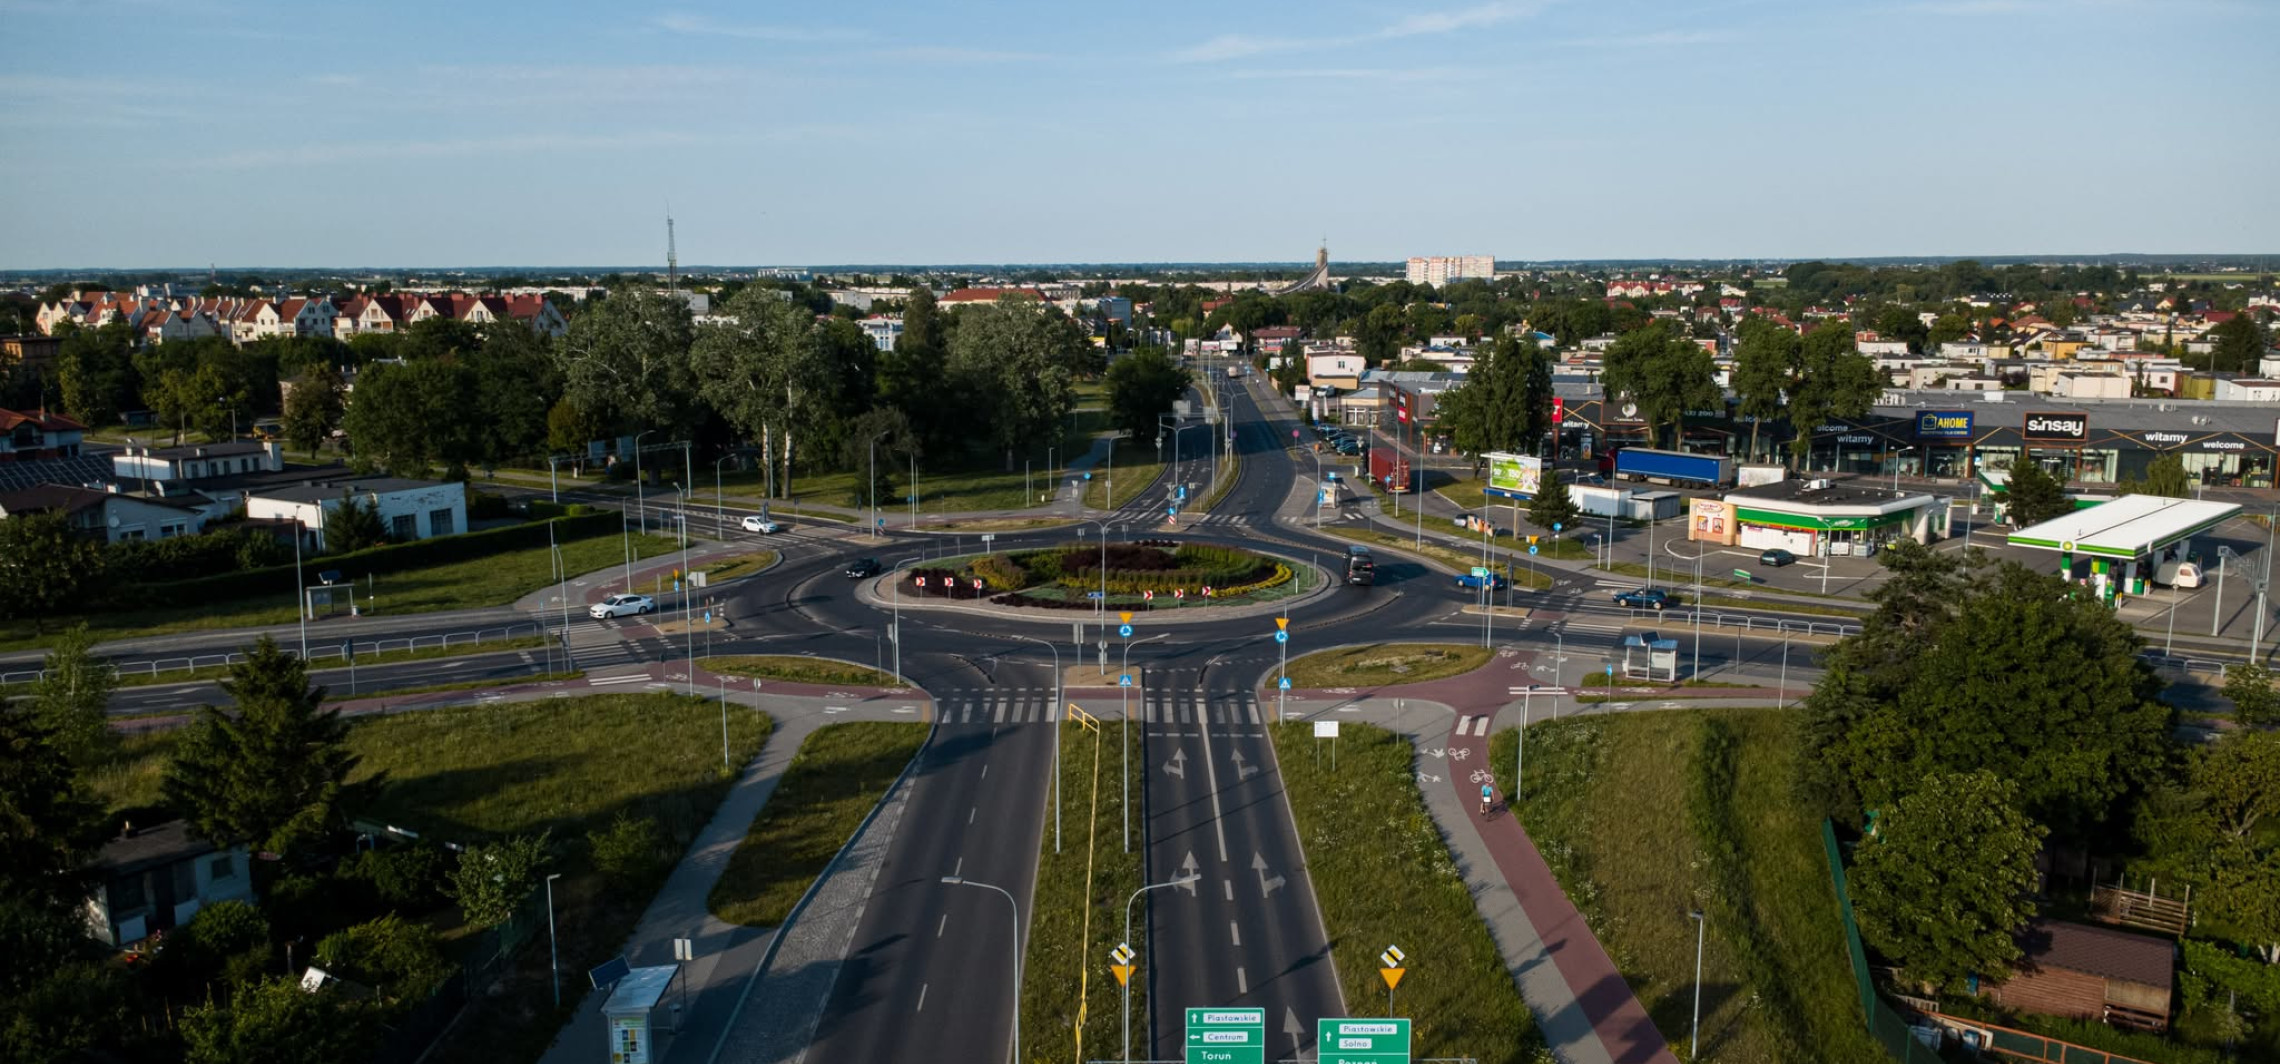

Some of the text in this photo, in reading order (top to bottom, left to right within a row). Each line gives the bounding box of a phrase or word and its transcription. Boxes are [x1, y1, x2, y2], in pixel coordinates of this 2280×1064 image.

[1816, 424, 1849, 433] elcome
[2027, 416, 2084, 436] sinsay
[1836, 433, 1875, 445] witamy
[2144, 432, 2188, 444] witamy
[2202, 441, 2245, 450] welcome
[1207, 1014, 1257, 1022] Piastowskie
[1343, 1025, 1393, 1033] Piastowskie
[1207, 1033, 1244, 1041] Centrum
[1201, 1050, 1232, 1061] Toruń
